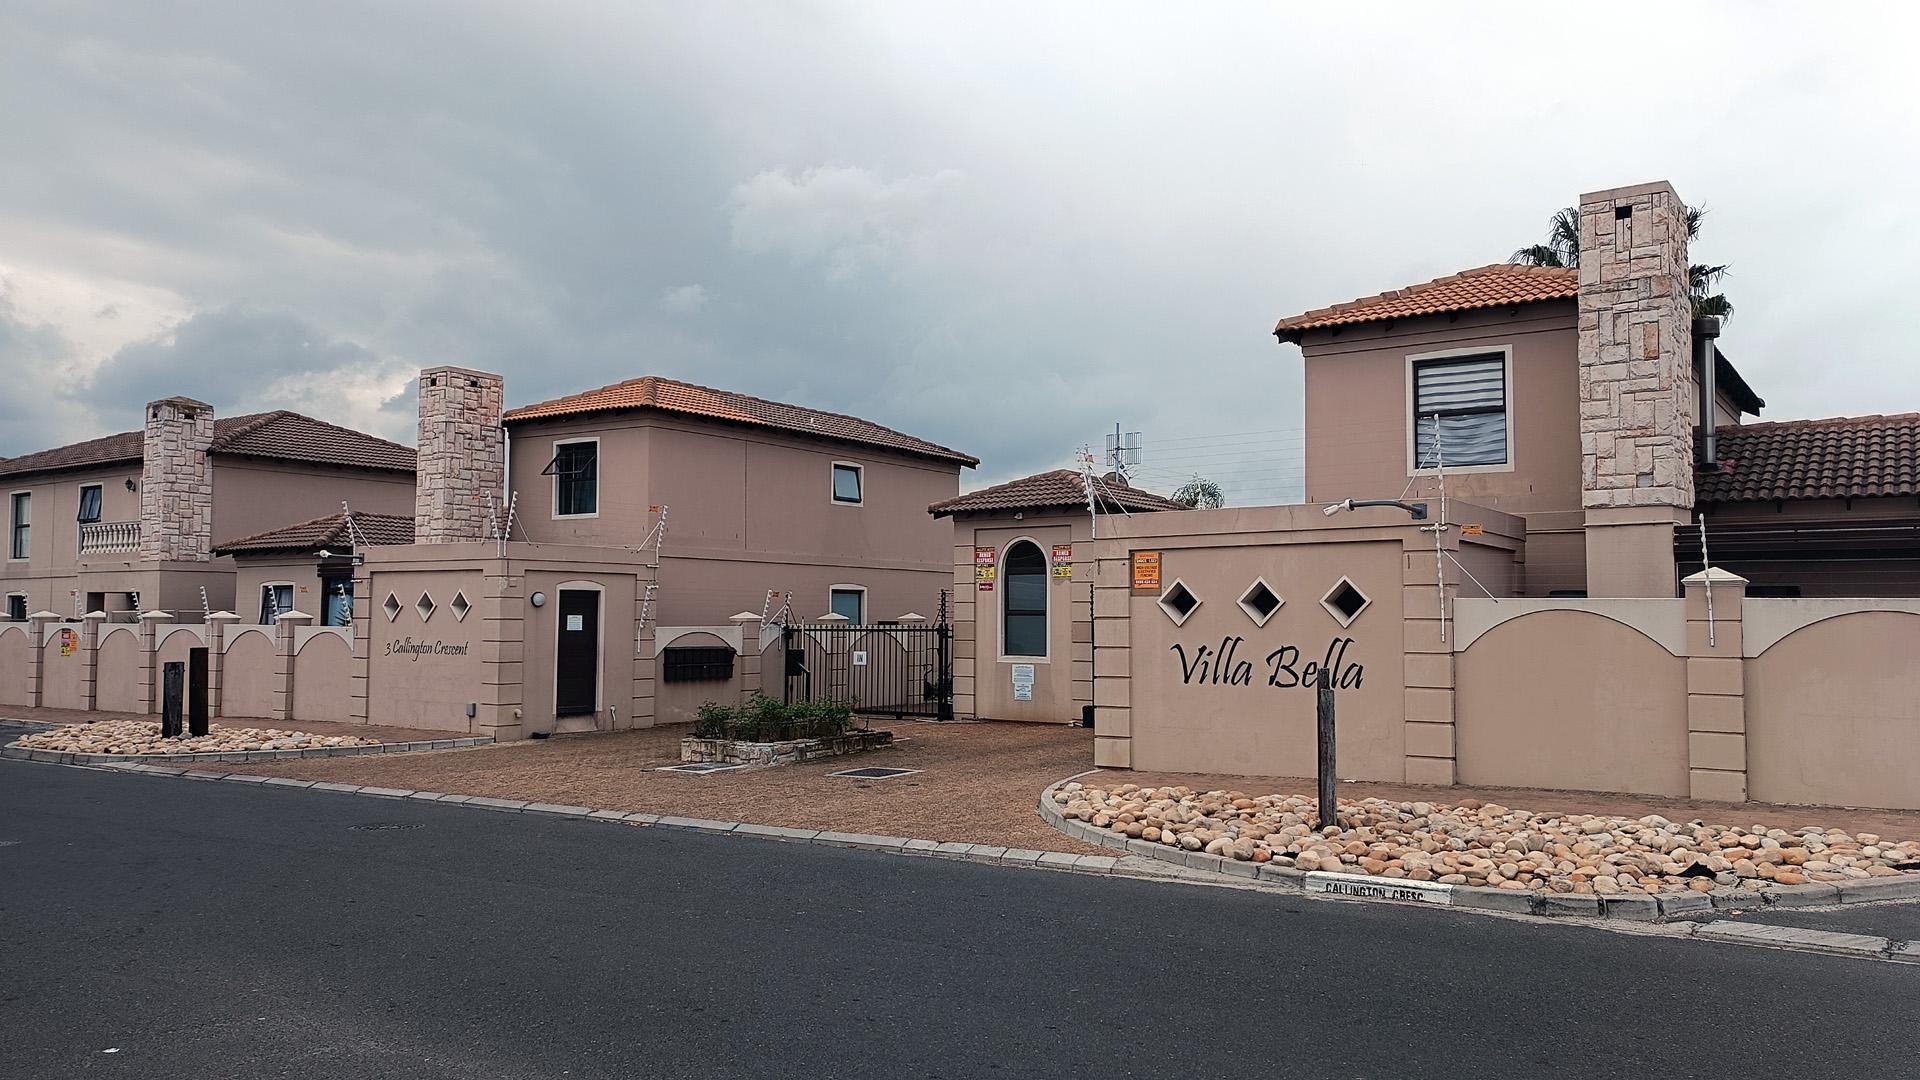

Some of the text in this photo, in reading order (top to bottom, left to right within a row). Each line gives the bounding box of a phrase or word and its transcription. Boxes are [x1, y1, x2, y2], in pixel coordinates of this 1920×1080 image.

[384, 636, 469, 662] 3 Callington Crescent
[1170, 636, 1364, 690] Villa Bella
